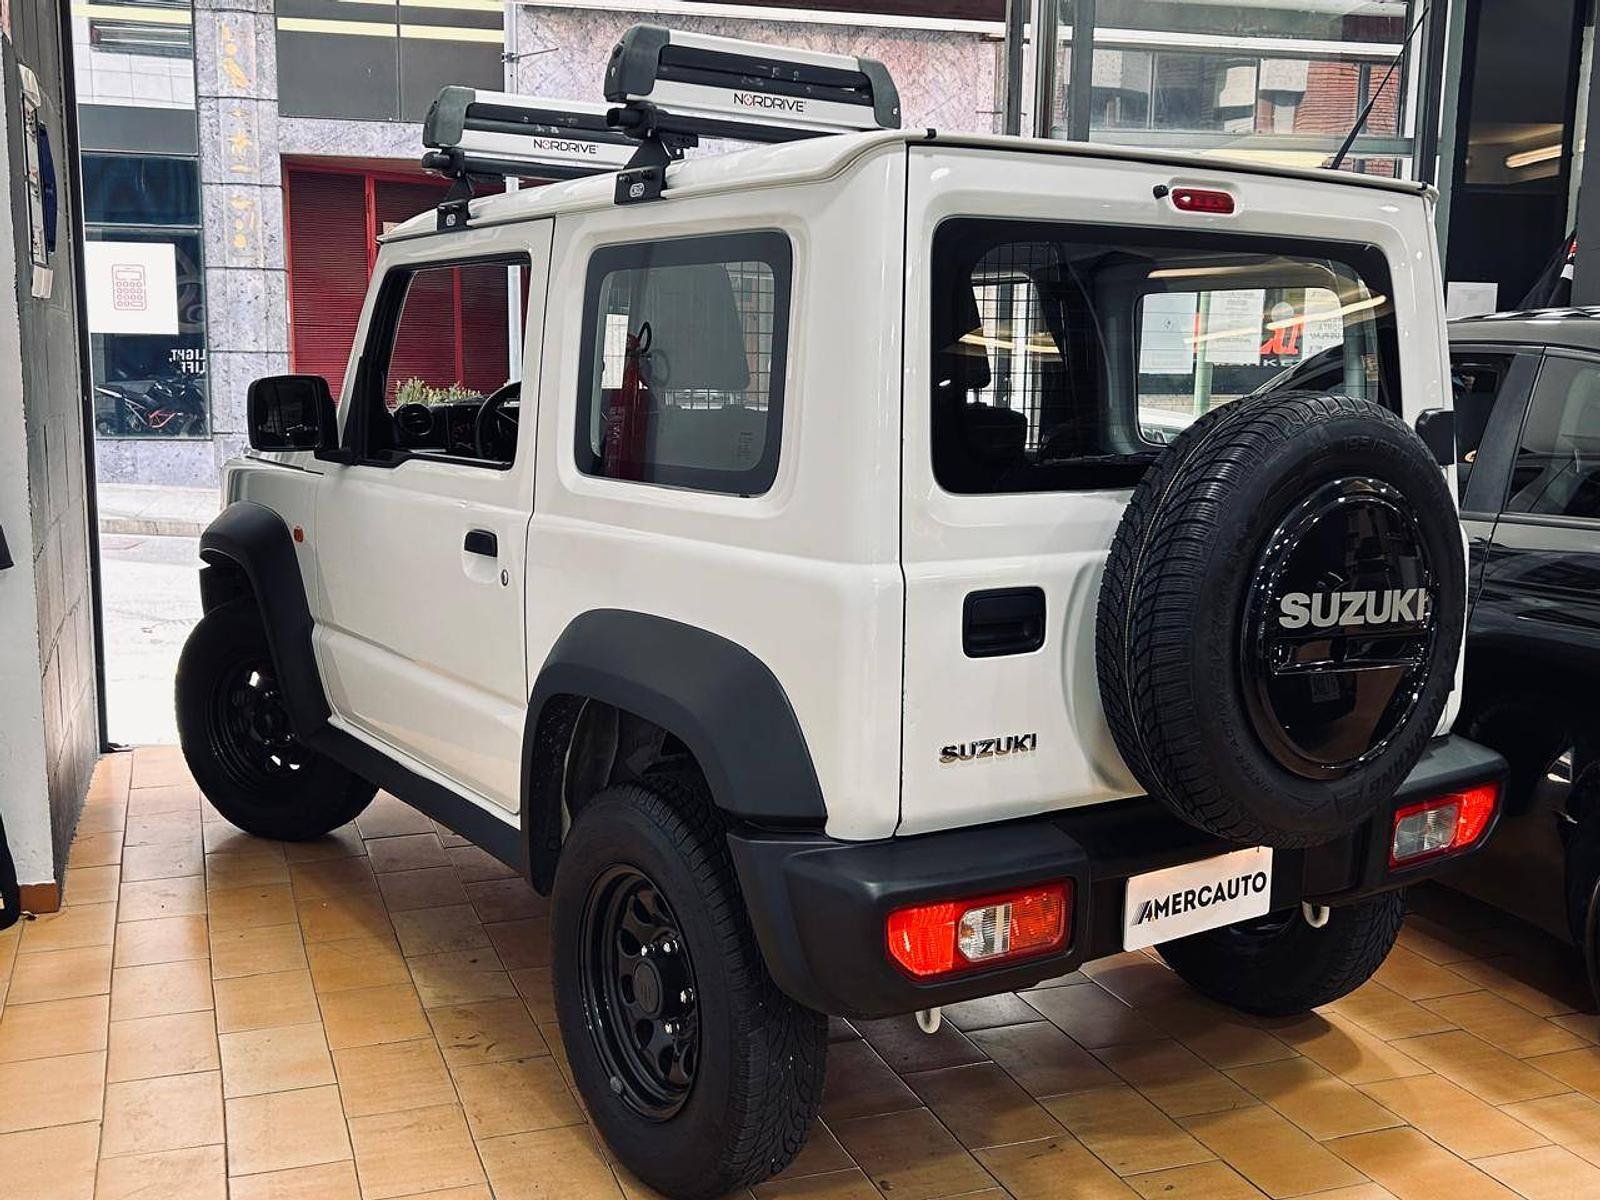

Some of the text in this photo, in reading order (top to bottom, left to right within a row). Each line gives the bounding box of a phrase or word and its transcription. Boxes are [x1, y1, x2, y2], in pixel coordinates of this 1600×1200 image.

[733, 92, 805, 113] NORDRIVE
[533, 138, 597, 155] NORDRIVE
[1278, 588, 1427, 629] SUZUKI
[939, 733, 1037, 764] SUZUKI
[1131, 871, 1267, 926] AMERCAUTO
